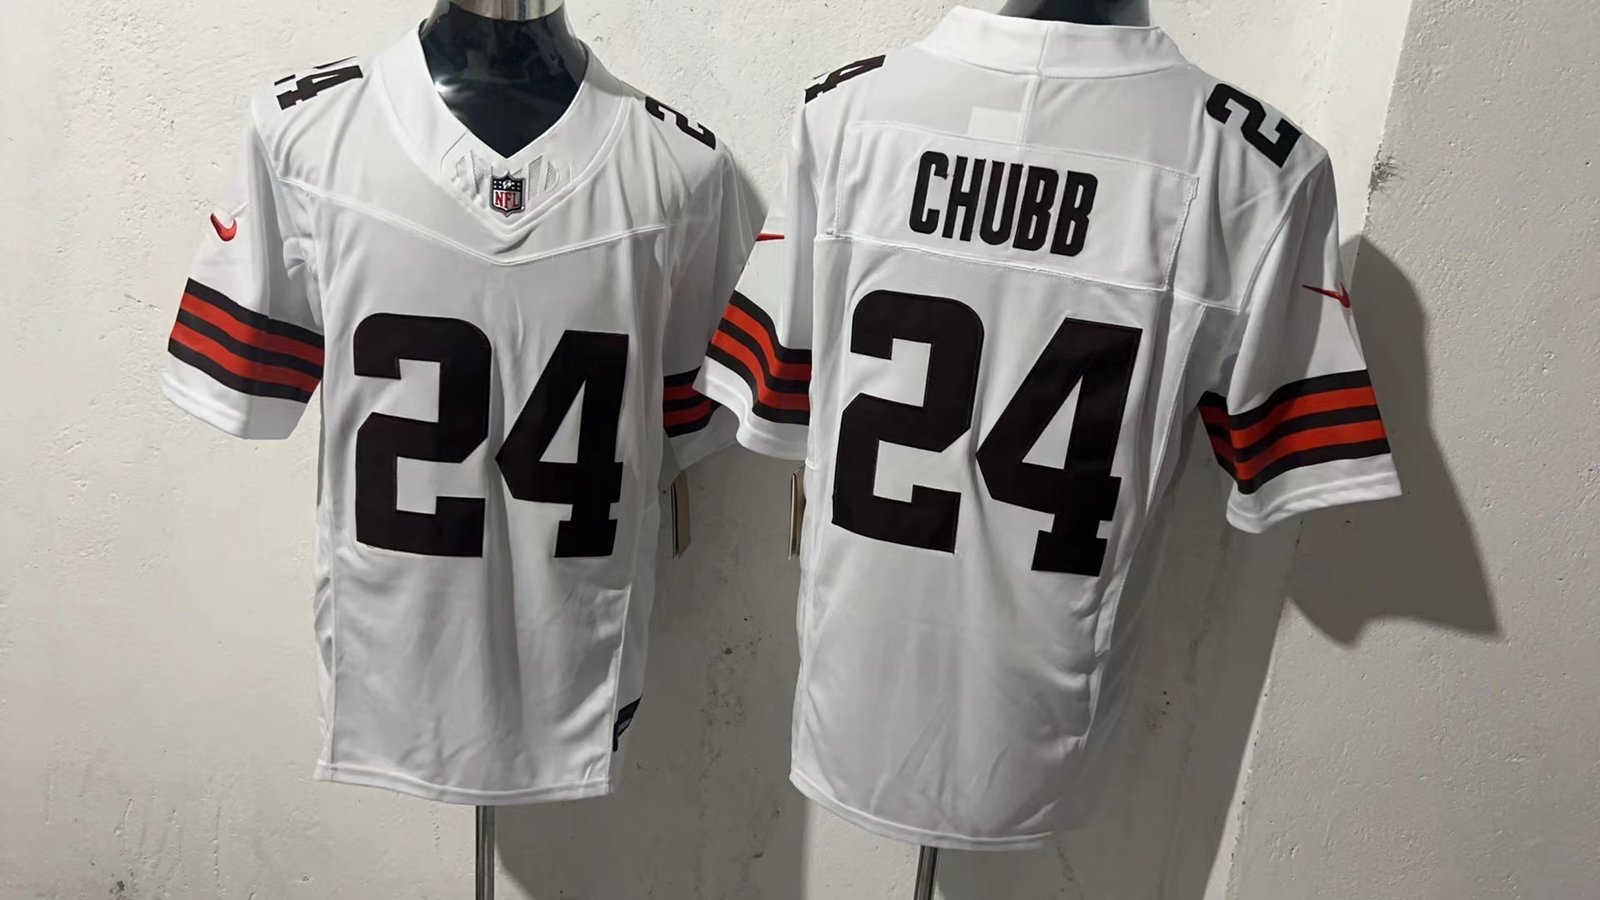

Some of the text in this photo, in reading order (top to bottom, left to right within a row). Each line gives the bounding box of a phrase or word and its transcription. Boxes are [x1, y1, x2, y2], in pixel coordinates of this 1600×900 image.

[804, 54, 886, 104] 4
[1205, 83, 1303, 169] 2
[494, 190, 520, 209] NFL
[908, 150, 1099, 257] CHUBB
[353, 312, 630, 559] 24
[831, 289, 1143, 578] 24
